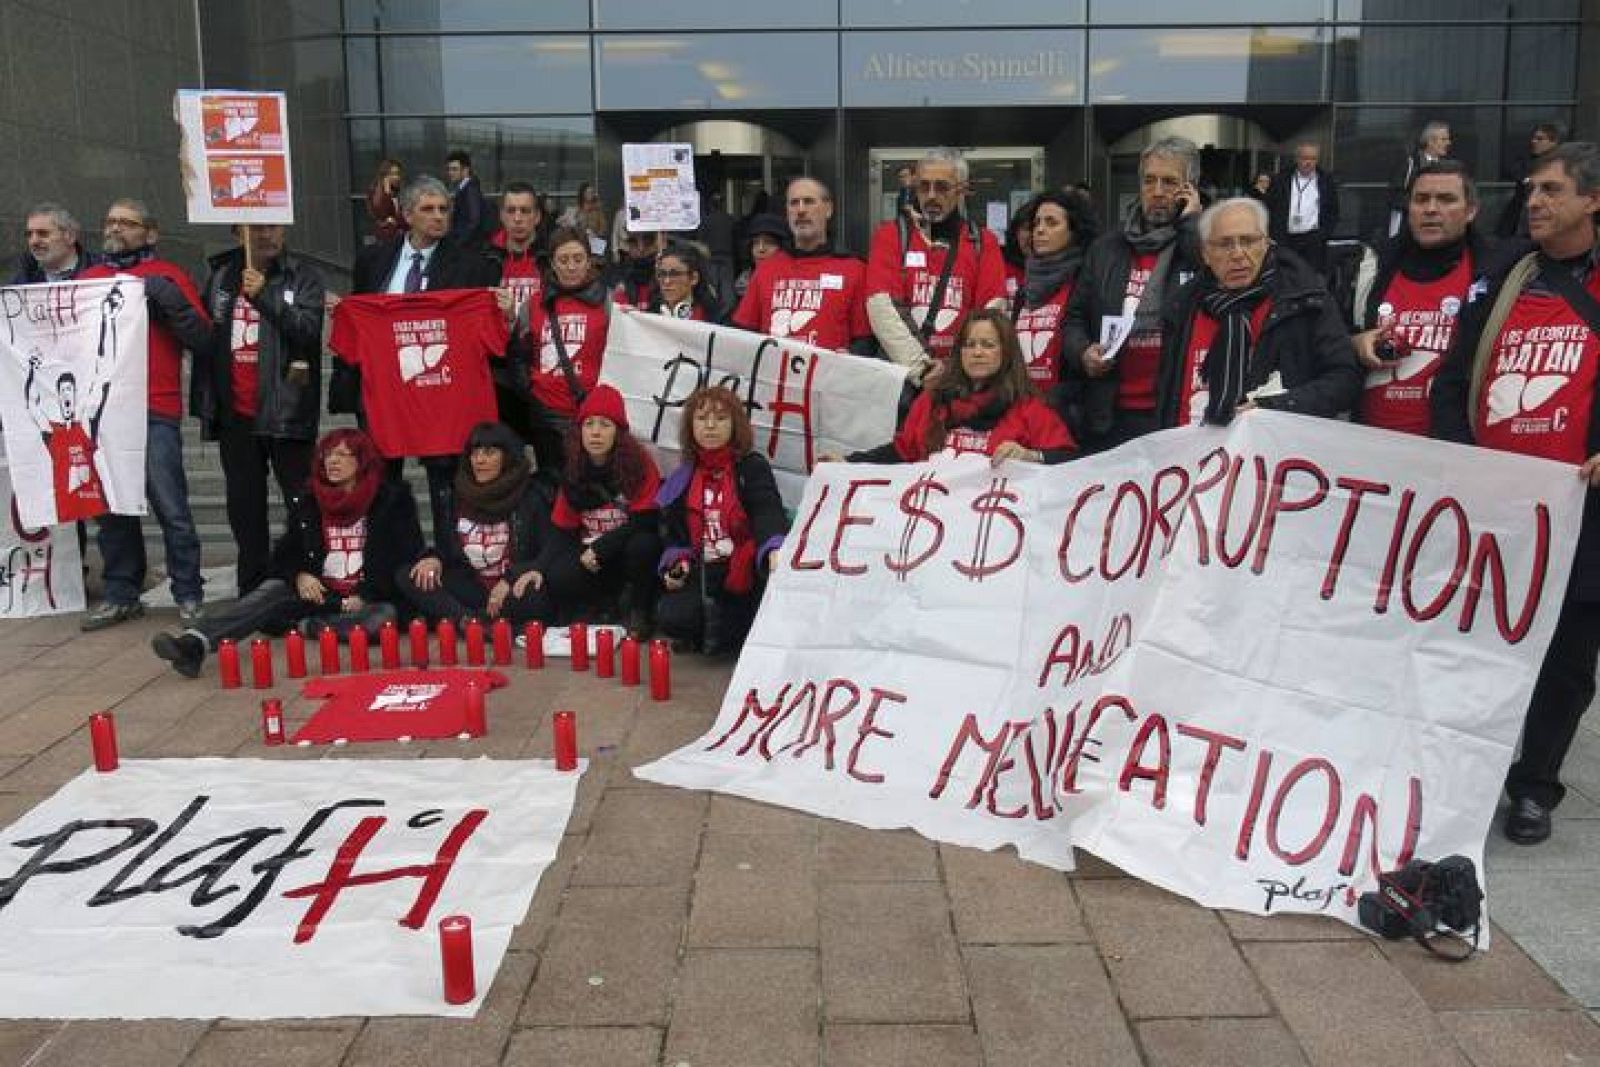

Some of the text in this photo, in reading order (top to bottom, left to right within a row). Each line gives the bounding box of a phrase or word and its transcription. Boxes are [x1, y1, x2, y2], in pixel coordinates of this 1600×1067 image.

[864, 51, 1067, 84] Altiero Spinelli
[1501, 323, 1590, 347] LOS RECORTES
[1495, 341, 1584, 375] MATAN
[1552, 406, 1569, 433] C
[790, 446, 1551, 644] LE$$ CORRUPTION
[1038, 612, 1132, 687] AND
[704, 678, 907, 783] MORE
